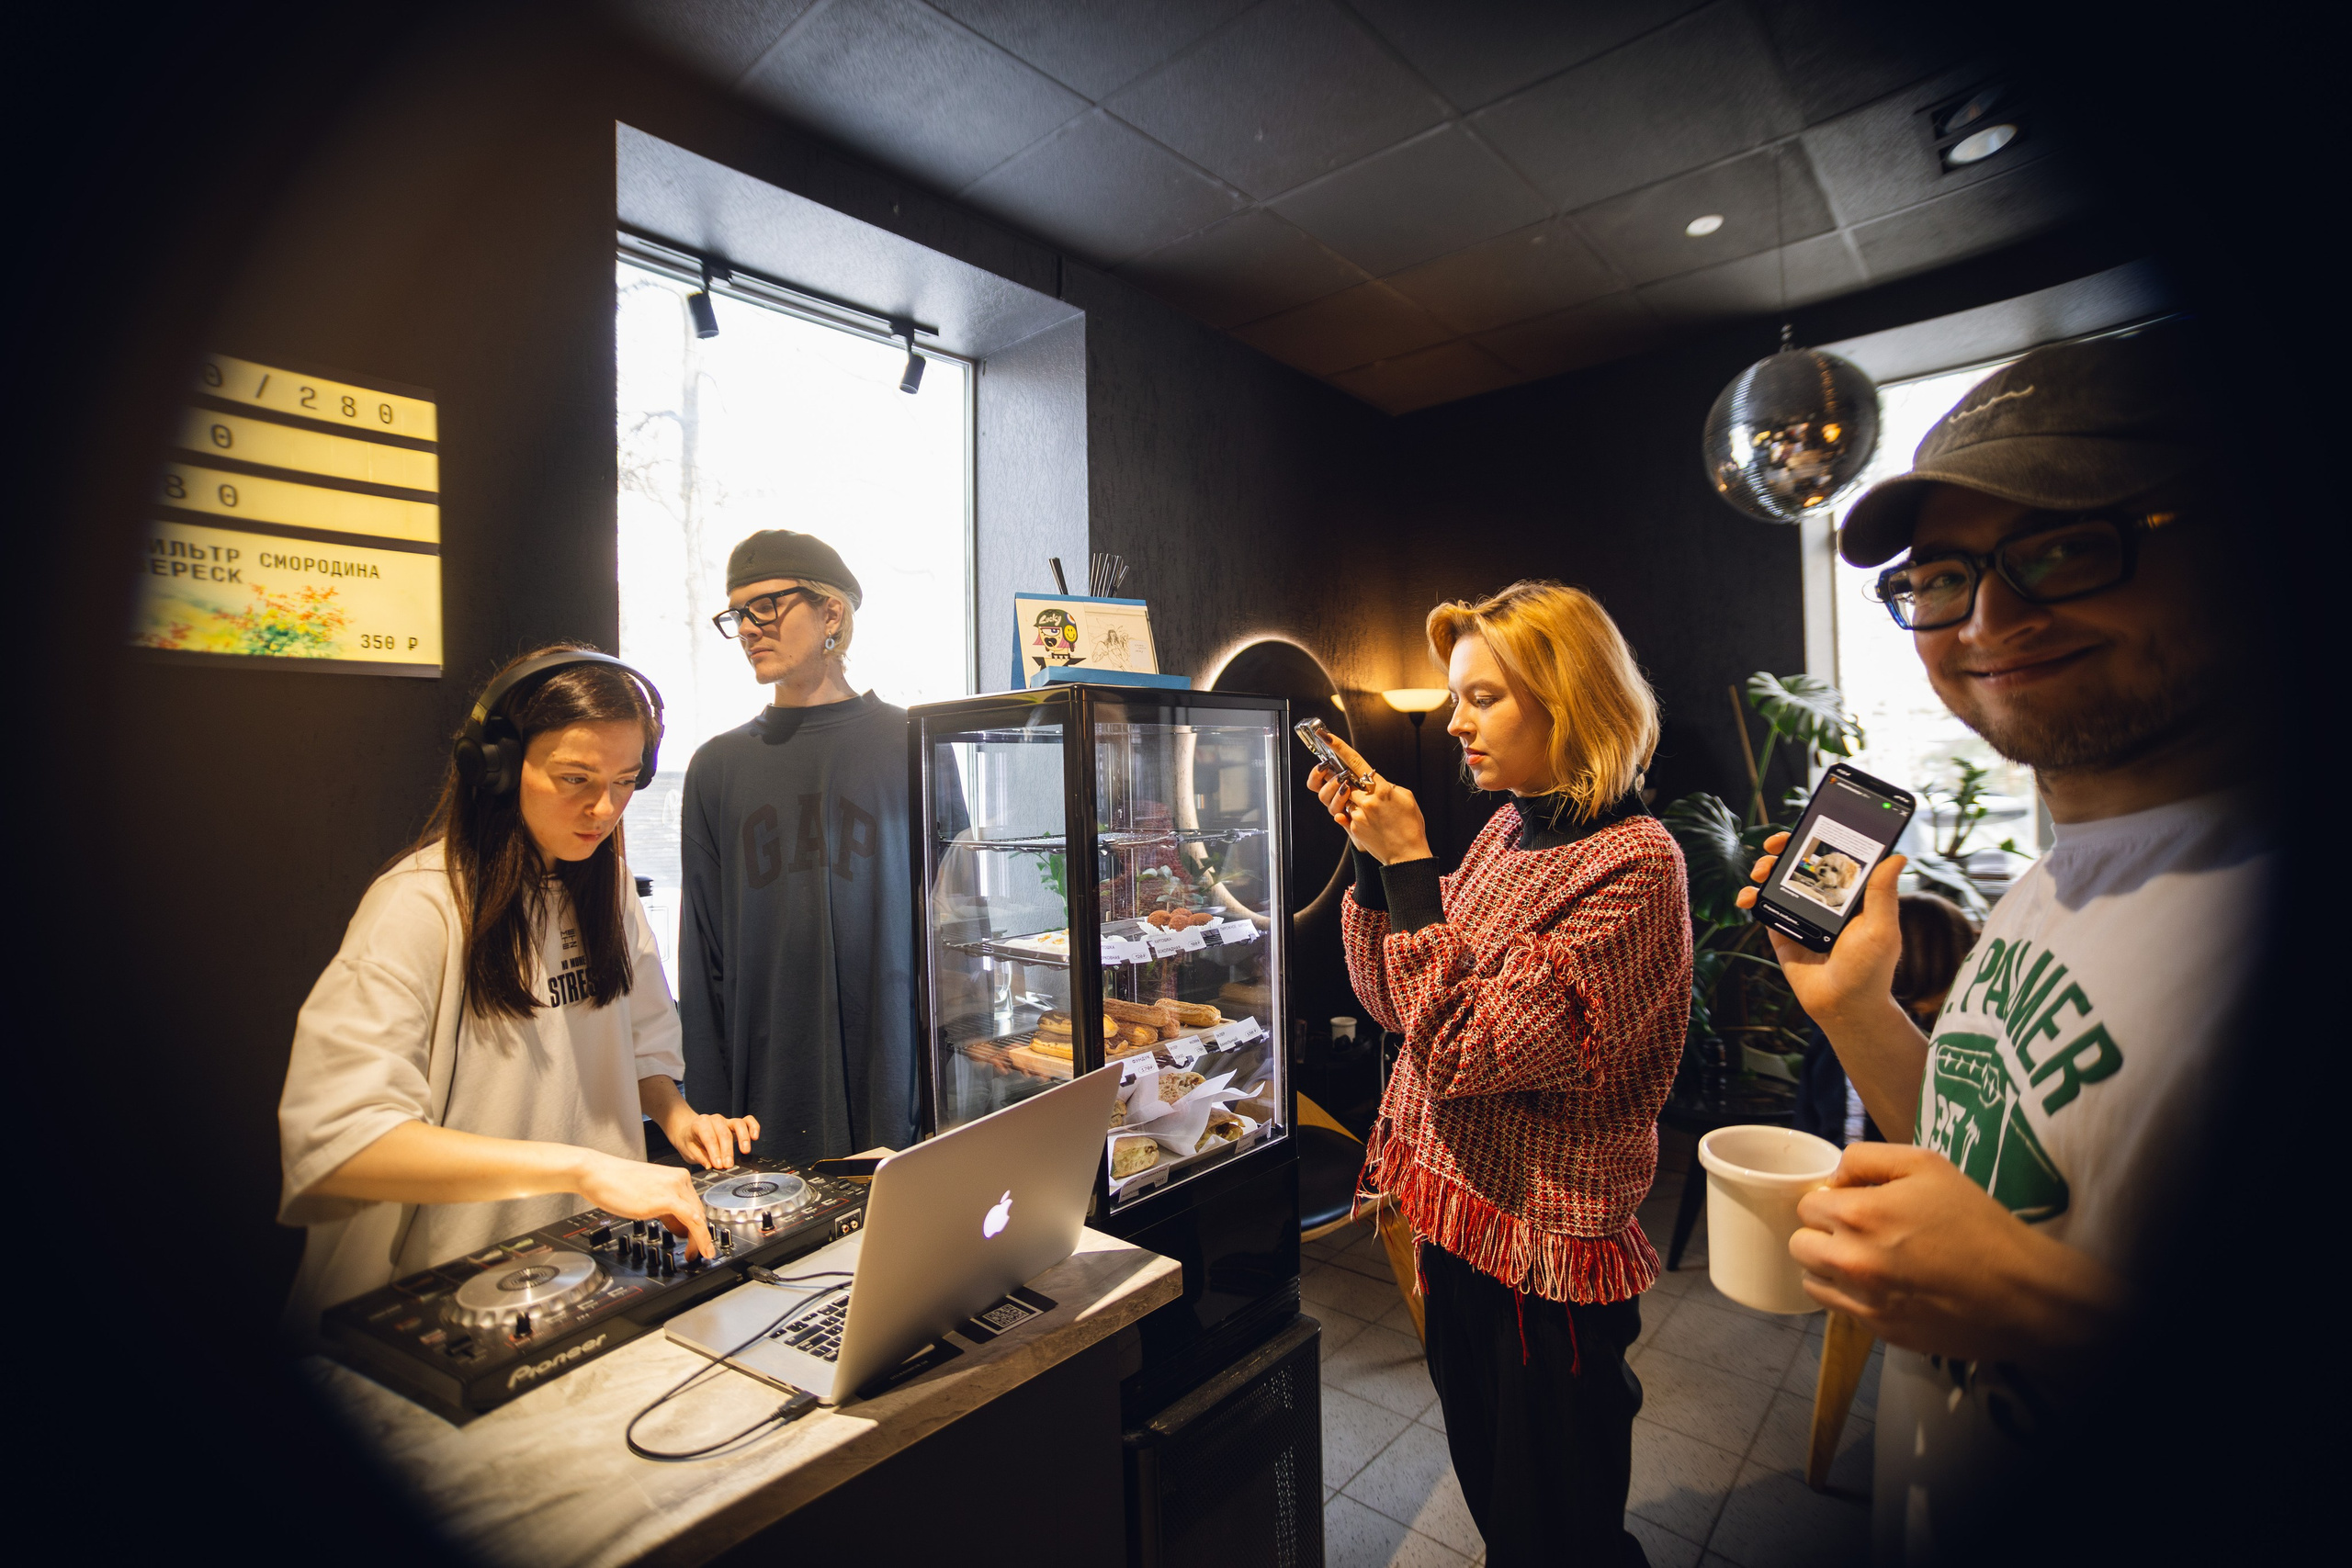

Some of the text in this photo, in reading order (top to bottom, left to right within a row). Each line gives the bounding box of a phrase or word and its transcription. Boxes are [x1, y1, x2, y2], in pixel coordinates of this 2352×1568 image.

[141, 557, 243, 585] ЕРЕСК
[258, 551, 381, 581] СМОРОДИНА
[1038, 612, 1062, 626] Lucky
[359, 633, 396, 650] 350
[741, 791, 877, 890] GAP
[506, 1333, 606, 1390] Pioneer
